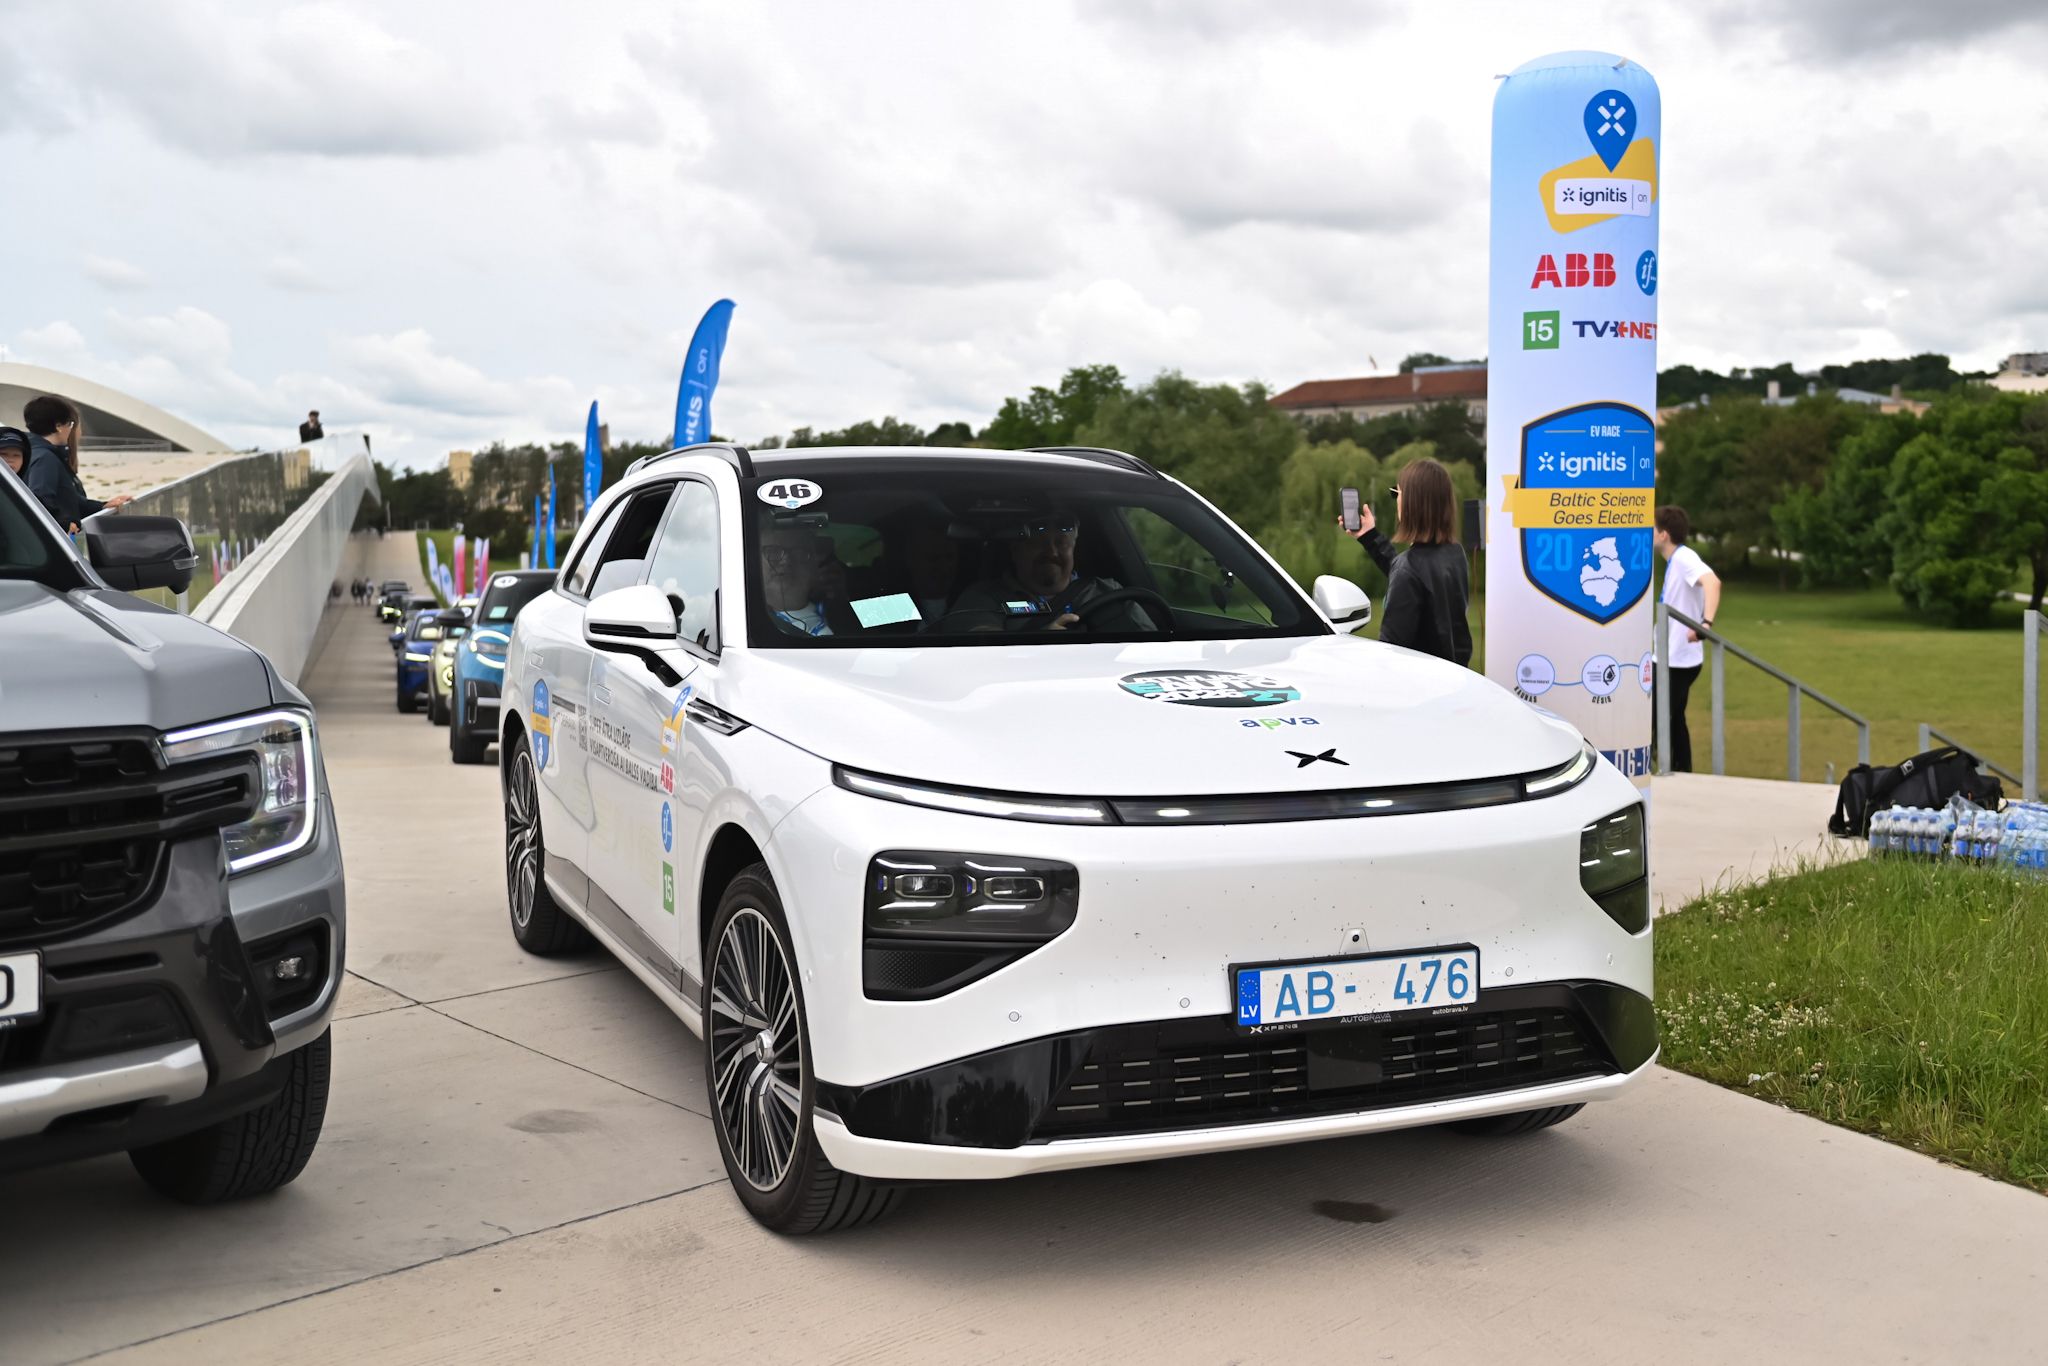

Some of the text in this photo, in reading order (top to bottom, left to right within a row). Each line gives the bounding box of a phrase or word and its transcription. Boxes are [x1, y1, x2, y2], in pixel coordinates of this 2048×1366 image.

[1579, 187, 1648, 206] ignitis on
[1530, 253, 1616, 288] ABB
[1527, 320, 1553, 342] 15
[1590, 426, 1620, 437] EV RACE
[1560, 451, 1650, 478] ignitis on
[768, 483, 812, 499] 46
[1550, 492, 1646, 507] Baltic Science
[1554, 510, 1644, 524] Goes Electric
[1536, 533, 1650, 572] 20 26
[1240, 716, 1320, 730] apva
[660, 762, 674, 794] ABB
[664, 872, 673, 902] 15
[1393, 958, 1469, 1005] 476
[1240, 1004, 1258, 1019] LV
[1340, 1012, 1392, 1024] AUTOBRAVA
[1432, 1006, 1468, 1016] autobrava.lv
